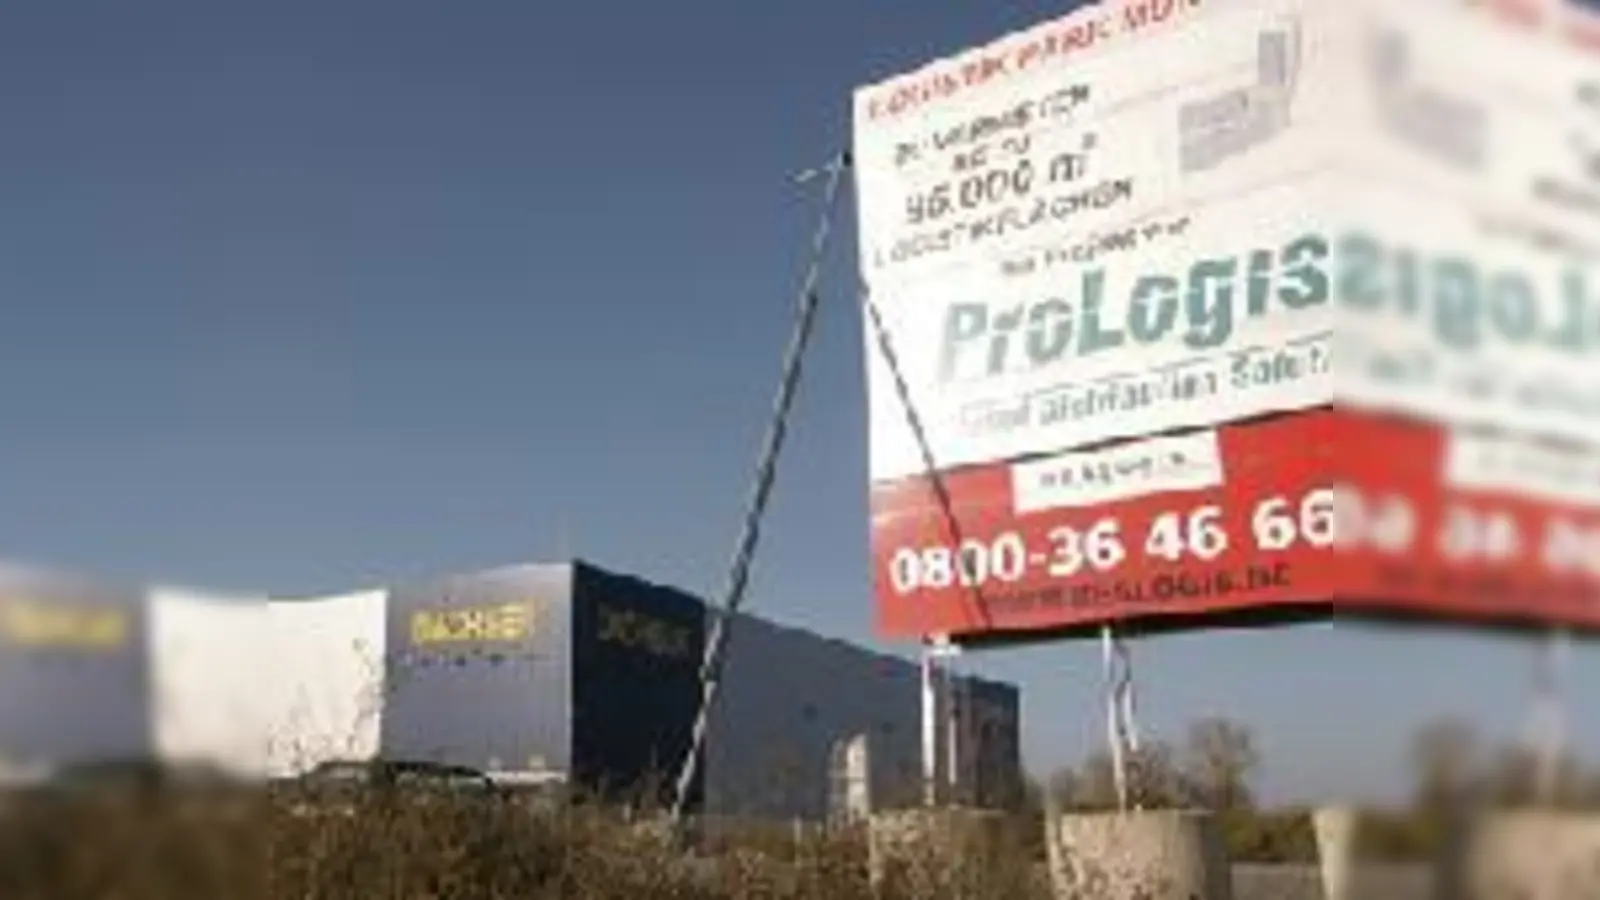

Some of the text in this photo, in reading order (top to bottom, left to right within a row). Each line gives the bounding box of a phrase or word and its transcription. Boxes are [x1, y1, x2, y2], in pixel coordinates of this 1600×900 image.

[889, 516, 1127, 594] 0800-36
[1144, 505, 1228, 563] 46
[1251, 489, 1334, 552] 66
